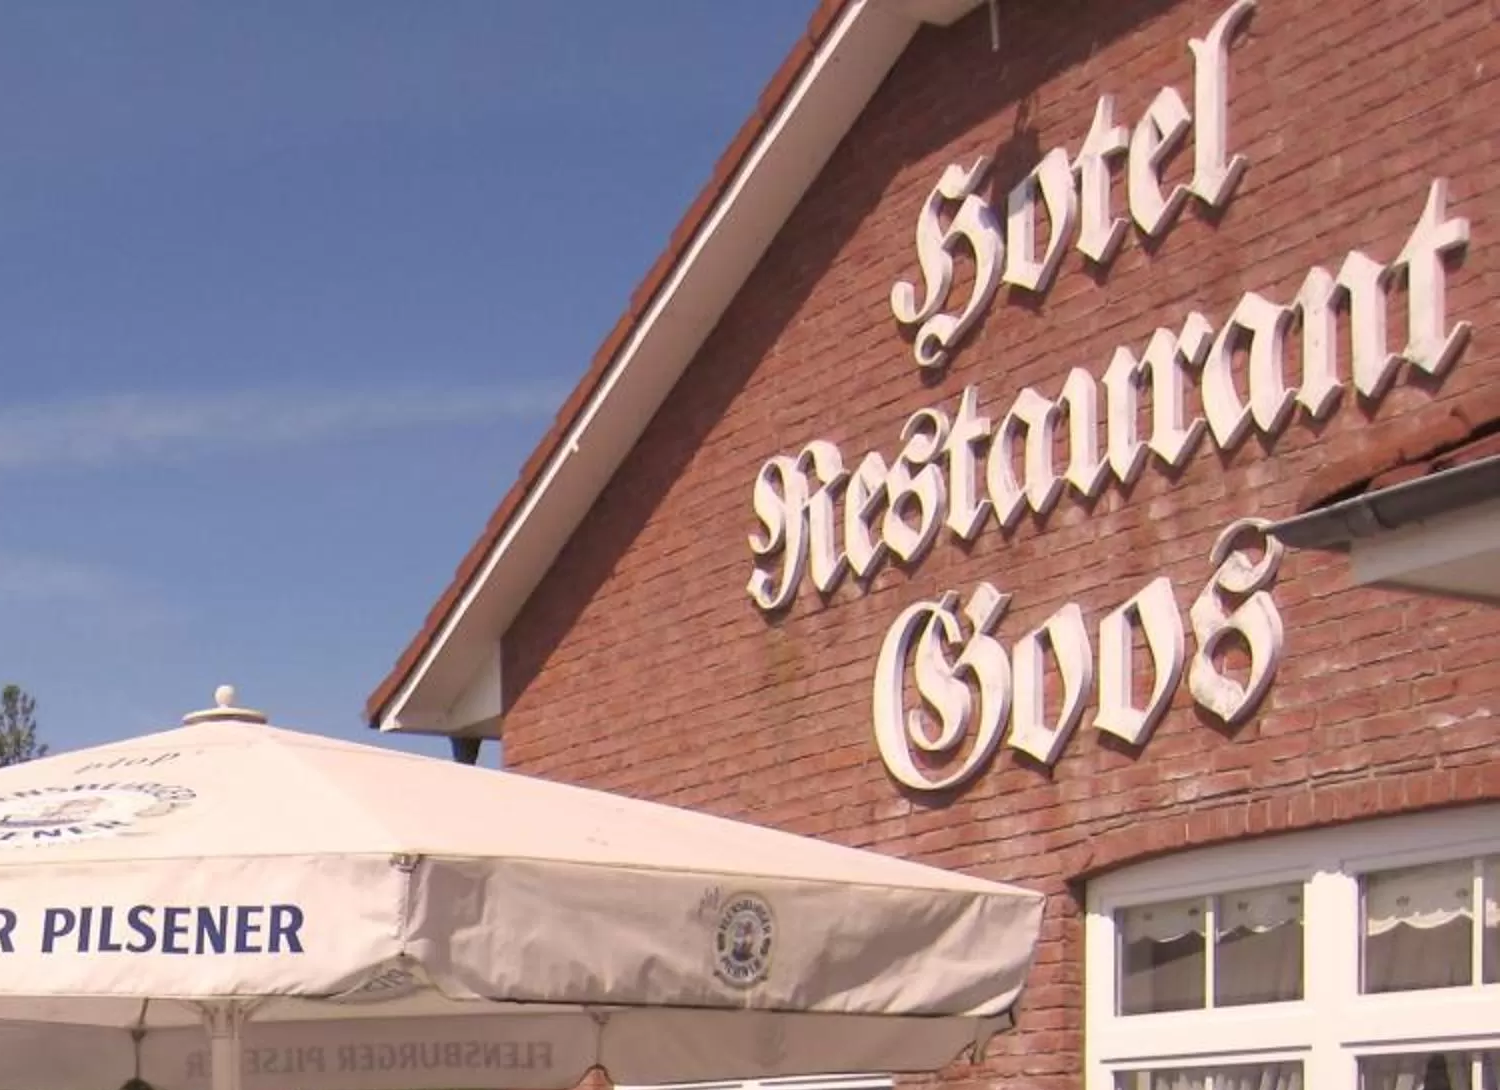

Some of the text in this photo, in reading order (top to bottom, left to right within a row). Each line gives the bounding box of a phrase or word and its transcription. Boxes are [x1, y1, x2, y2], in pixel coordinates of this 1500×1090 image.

[891, 0, 1257, 367] Hotel
[747, 178, 1472, 611] Restaurant
[872, 517, 1286, 793] Goos
[41, 904, 305, 954] PILSENER
